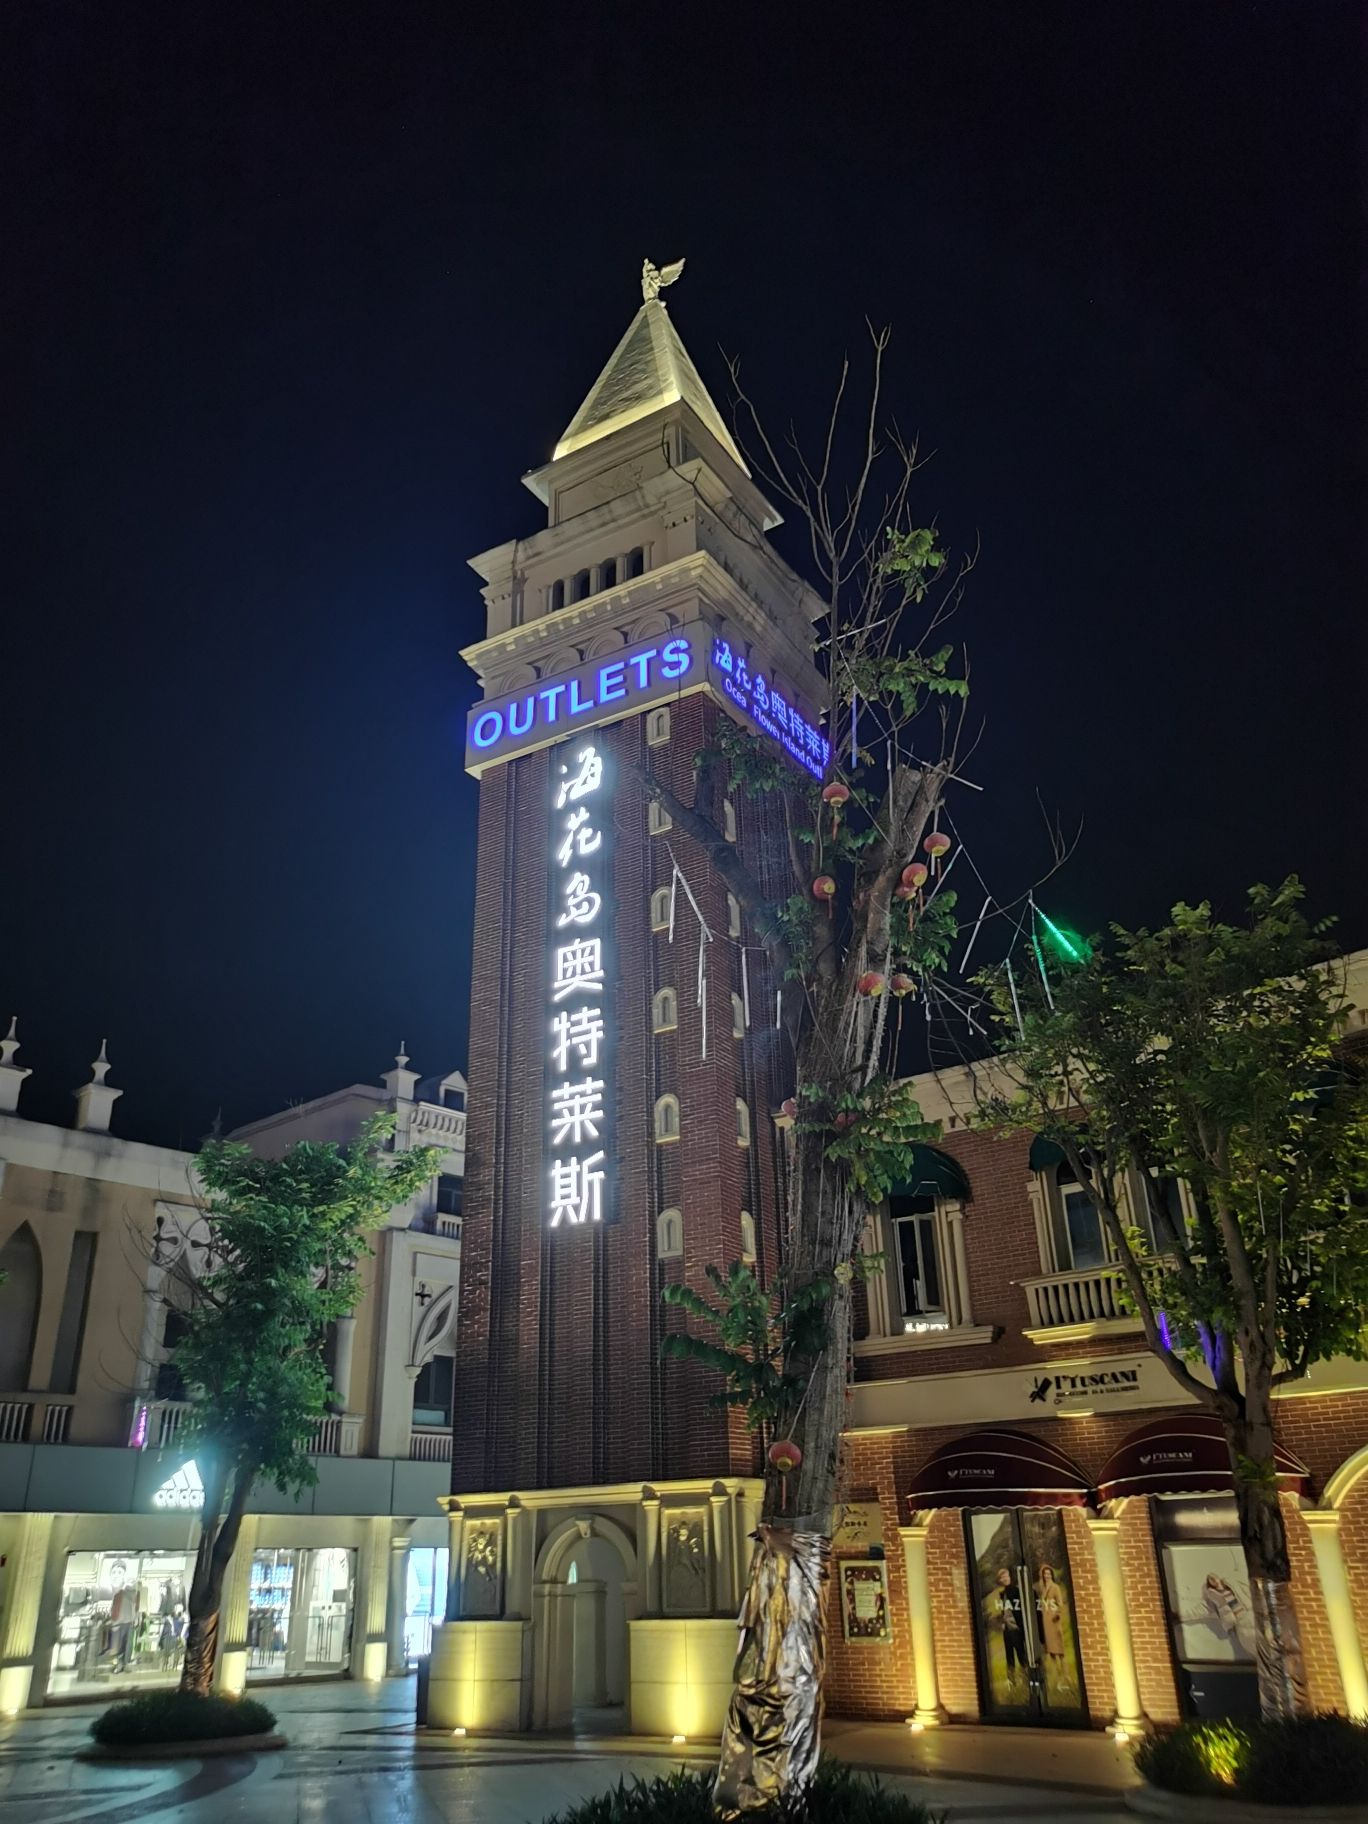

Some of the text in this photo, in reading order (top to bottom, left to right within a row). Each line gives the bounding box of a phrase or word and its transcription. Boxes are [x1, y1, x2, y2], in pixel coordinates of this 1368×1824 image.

[472, 638, 692, 749] OUTLETS
[549, 745, 606, 1228] 海花岛奥特莱斯
